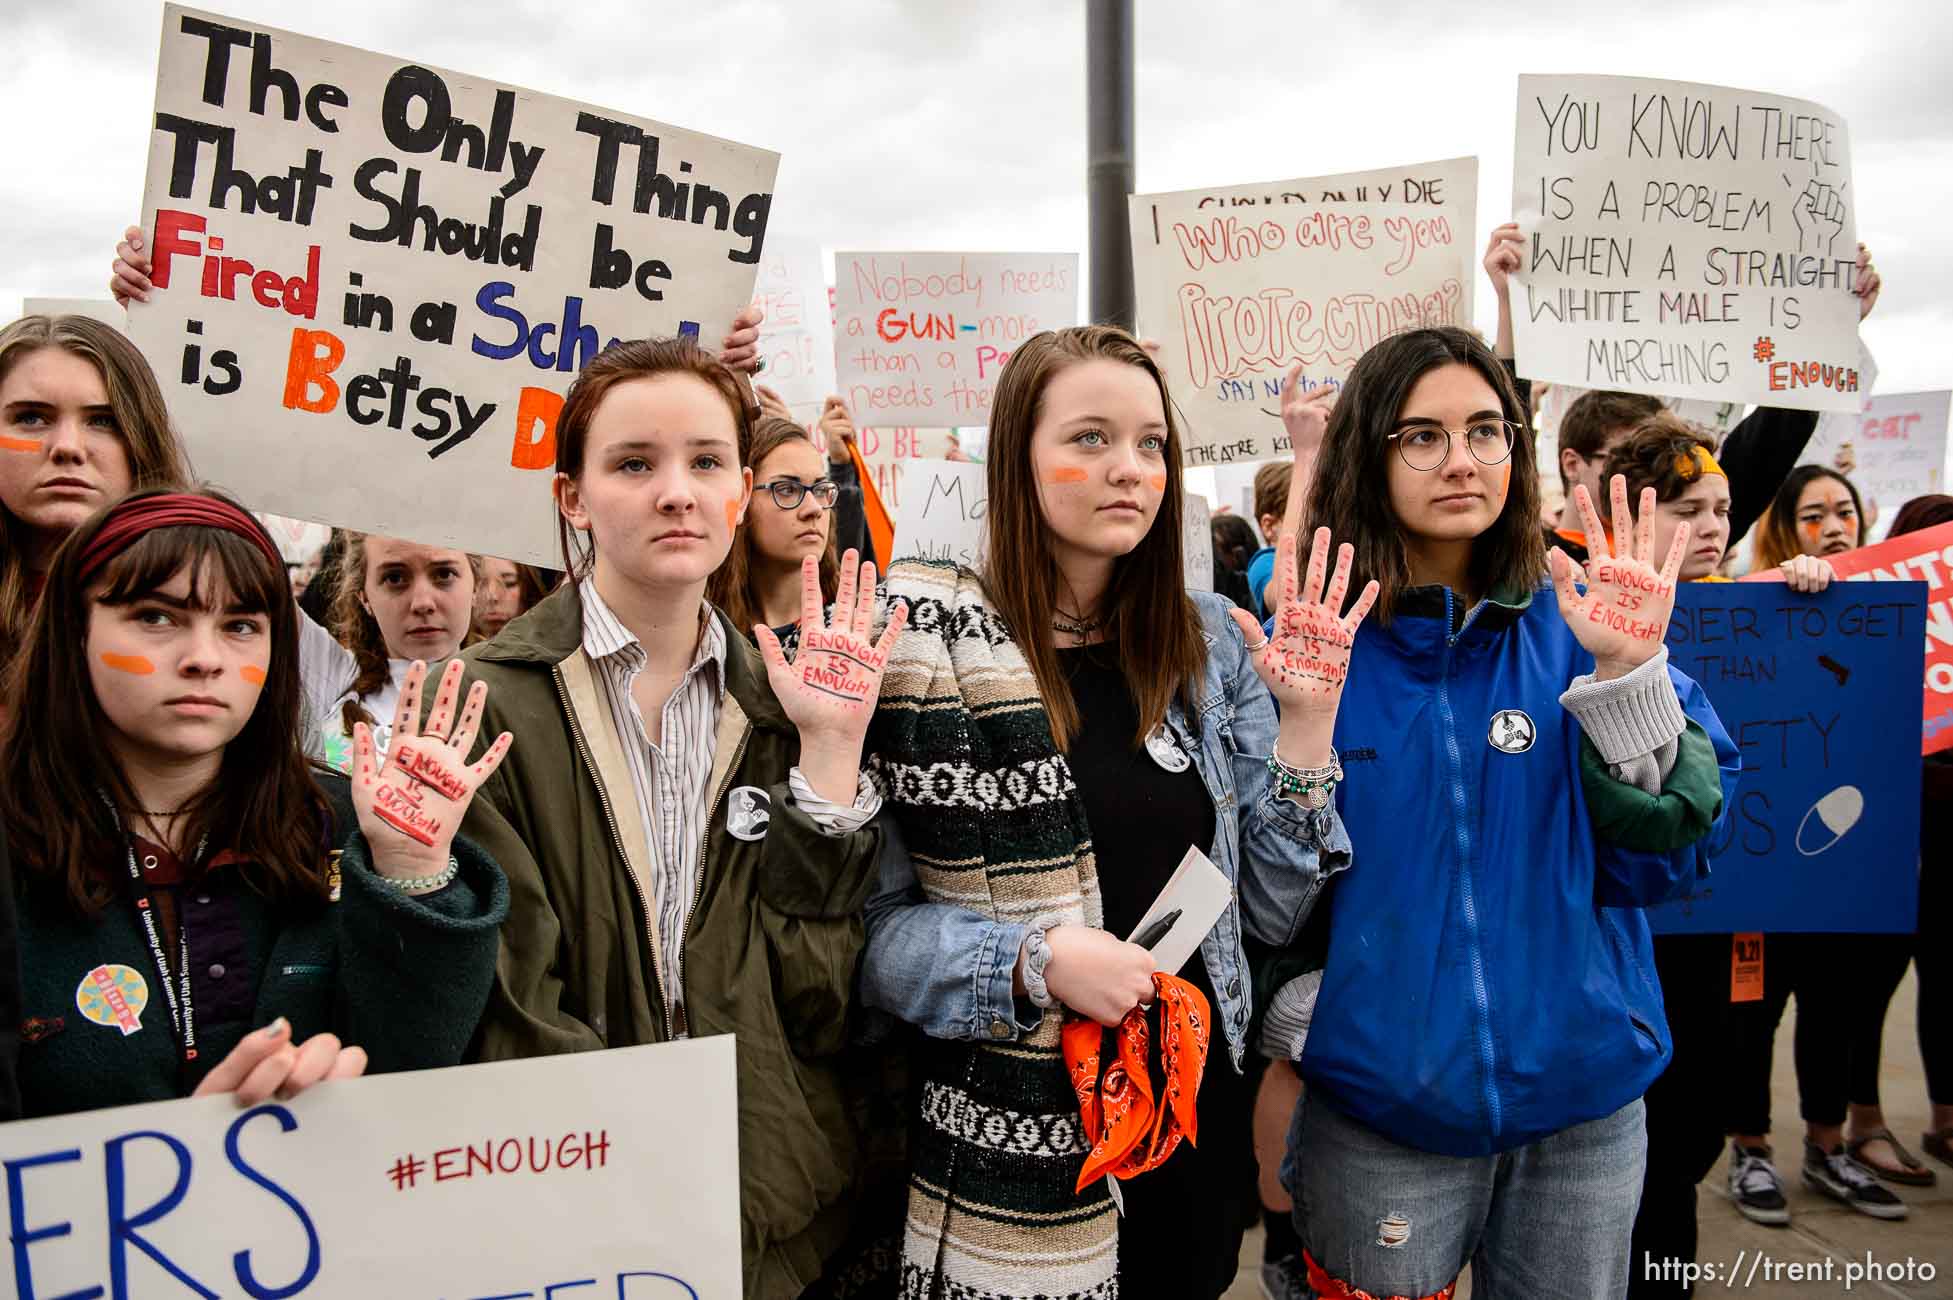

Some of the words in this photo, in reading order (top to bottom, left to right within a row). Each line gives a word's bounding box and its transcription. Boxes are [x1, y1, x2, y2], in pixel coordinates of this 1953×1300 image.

[180, 16, 348, 133] The
[381, 65, 546, 195] Only
[576, 111, 773, 264] Thing
[1537, 94, 1600, 156] YOU
[1628, 93, 1740, 160] KNOW
[1751, 107, 1839, 167] THERE
[155, 113, 332, 227] That
[348, 157, 542, 273] Should
[590, 224, 672, 301] be
[1404, 178, 1443, 204] DIE
[1541, 177, 1574, 219] IS
[1598, 180, 1620, 219] A
[1642, 182, 1772, 233] PROBLEM
[1173, 216, 1285, 271] Who
[1296, 212, 1374, 251] are
[1384, 216, 1451, 276] you
[151, 209, 321, 320] Fired
[343, 272, 393, 333] in
[410, 302, 457, 345] a
[853, 256, 983, 308] Nobody
[1000, 264, 1067, 294] needs
[1532, 233, 1632, 279] WHEN
[1659, 245, 1676, 280] A
[1703, 247, 1858, 294] STRAIGHT
[1528, 285, 1641, 324] WHITE
[1659, 292, 1740, 324] MALE
[1769, 297, 1800, 330] IS
[847, 318, 863, 336] a
[853, 348, 920, 373] than
[937, 352, 956, 369] a
[1586, 338, 1730, 385] MARCHING
[181, 320, 242, 395] is
[283, 328, 497, 460] Betsy
[849, 380, 934, 412] needs
[1217, 378, 1255, 401] SAY
[1186, 438, 1258, 464] THEATRE
[1600, 566, 1672, 599] ENOUGH
[1617, 592, 1642, 610] IS
[1589, 602, 1662, 641] ENOUGH
[1776, 608, 1826, 641] TO
[1838, 603, 1917, 640] GET
[806, 631, 885, 668] ENOUGH
[828, 655, 850, 675] IS
[803, 666, 870, 695] ENOUGH
[1695, 655, 1776, 684] THAN
[396, 745, 467, 800] ENOUGH
[141, 910, 162, 949] University
[154, 948, 165, 958] of
[157, 957, 170, 977] Utah
[180, 945, 189, 976] Summer
[162, 976, 178, 1010] Summer
[181, 977, 191, 997] Utah
[182, 997, 191, 1006] of
[184, 1007, 195, 1047] University
[387, 1130, 610, 1190] #ENOUGH
[3, 1104, 320, 1300] ERS
